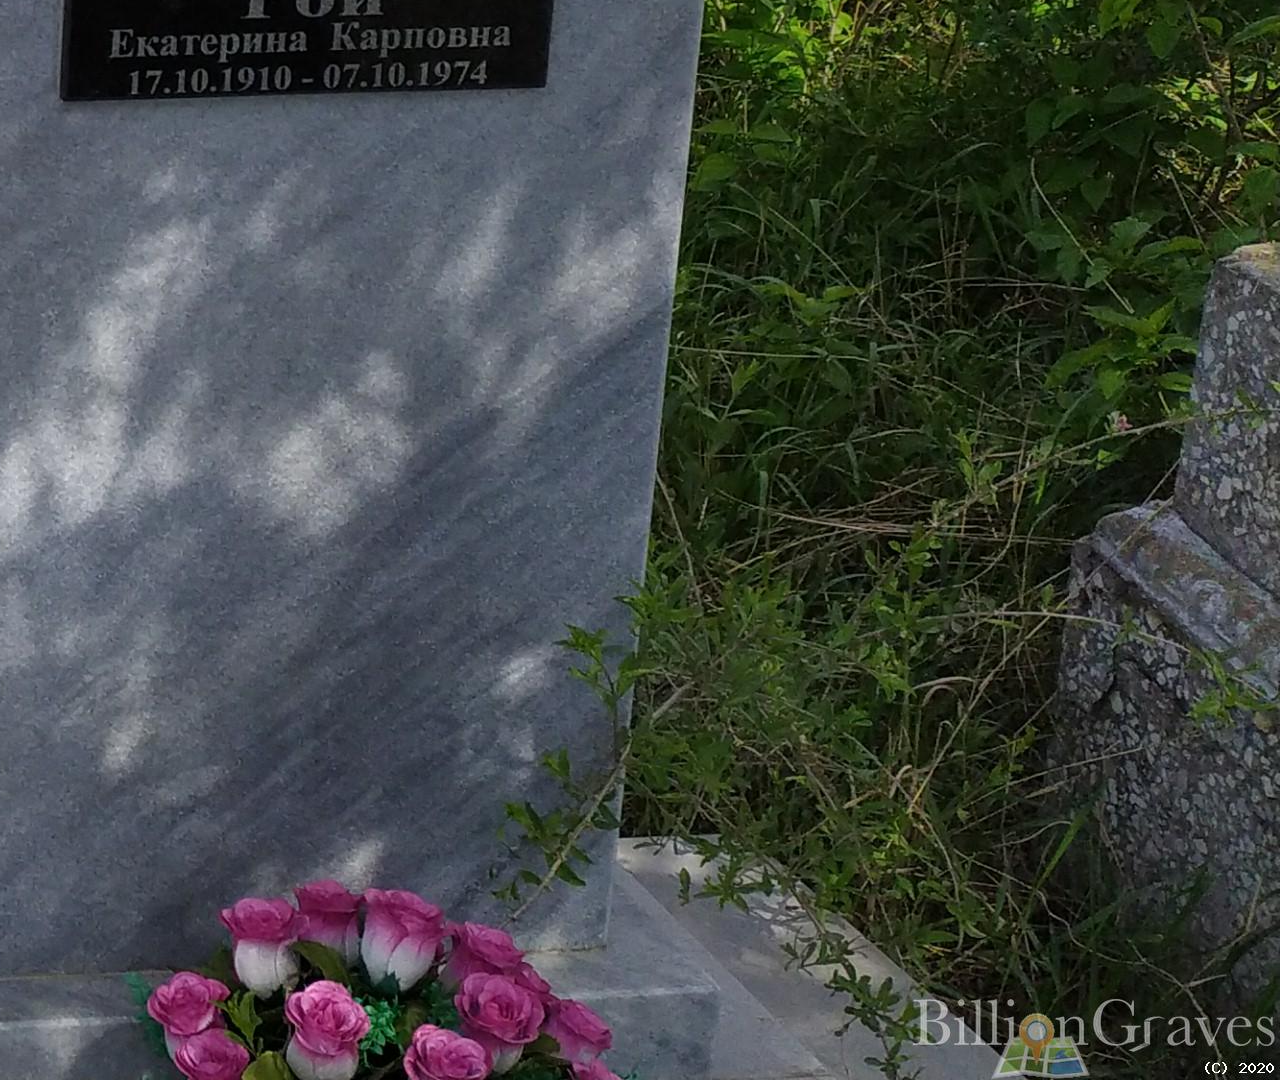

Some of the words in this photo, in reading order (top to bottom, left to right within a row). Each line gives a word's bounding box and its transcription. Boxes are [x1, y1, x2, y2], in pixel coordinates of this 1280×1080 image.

[108, 28, 308, 63] Екатерина
[330, 21, 511, 58] Карповна
[128, 64, 292, 96] 17.10.1910
[323, 59, 489, 89] 07.10.1974
